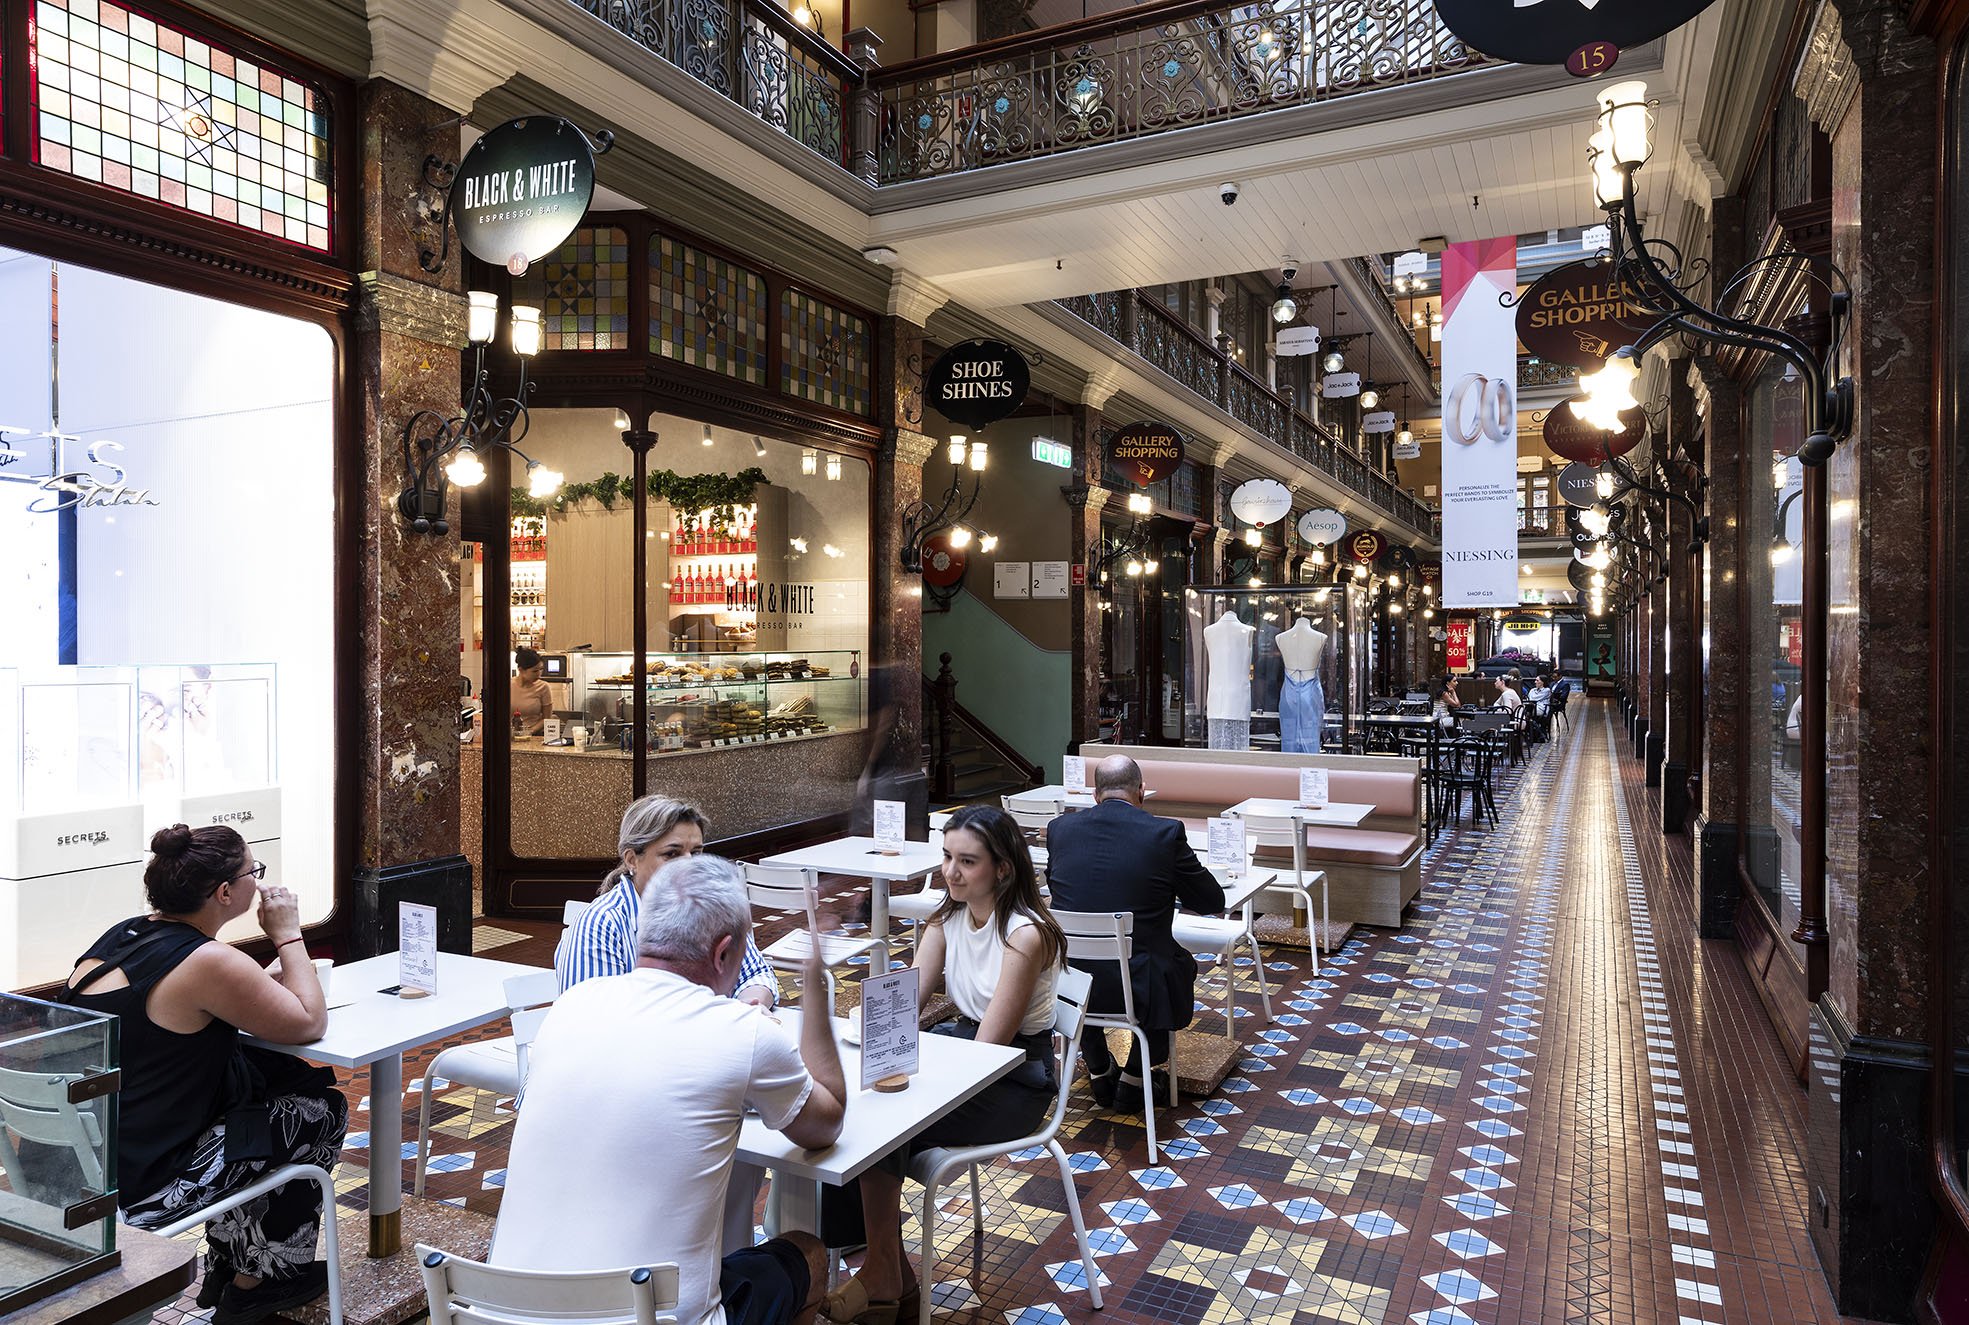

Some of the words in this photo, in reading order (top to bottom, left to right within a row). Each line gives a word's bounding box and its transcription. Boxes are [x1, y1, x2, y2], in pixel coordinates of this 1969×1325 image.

[1578, 45, 1606, 71] 15
[464, 171, 510, 210] BLACK
[512, 168, 525, 202] &
[529, 159, 577, 199] WHITE
[479, 208, 533, 224] ESPRESSO
[538, 204, 560, 215] BAR
[513, 258, 523, 271] 18
[1529, 293, 1650, 328] SHOPPIN
[951, 360, 1004, 379] SHOE
[942, 380, 1013, 400] SHINES
[1121, 435, 1175, 447] GALLERY
[1114, 446, 1178, 458] SHOPPING
[1306, 521, 1338, 532] Aesop
[1446, 549, 1514, 562] NIESSING
[996, 580, 1001, 589] 1
[1033, 579, 1040, 589] 2
[726, 581, 764, 613] BLACK
[767, 583, 777, 613] &
[780, 583, 814, 614] WHITE
[788, 621, 803, 630] BAR
[211, 811, 252, 824] SECRETS
[57, 831, 107, 846] SECRETS
